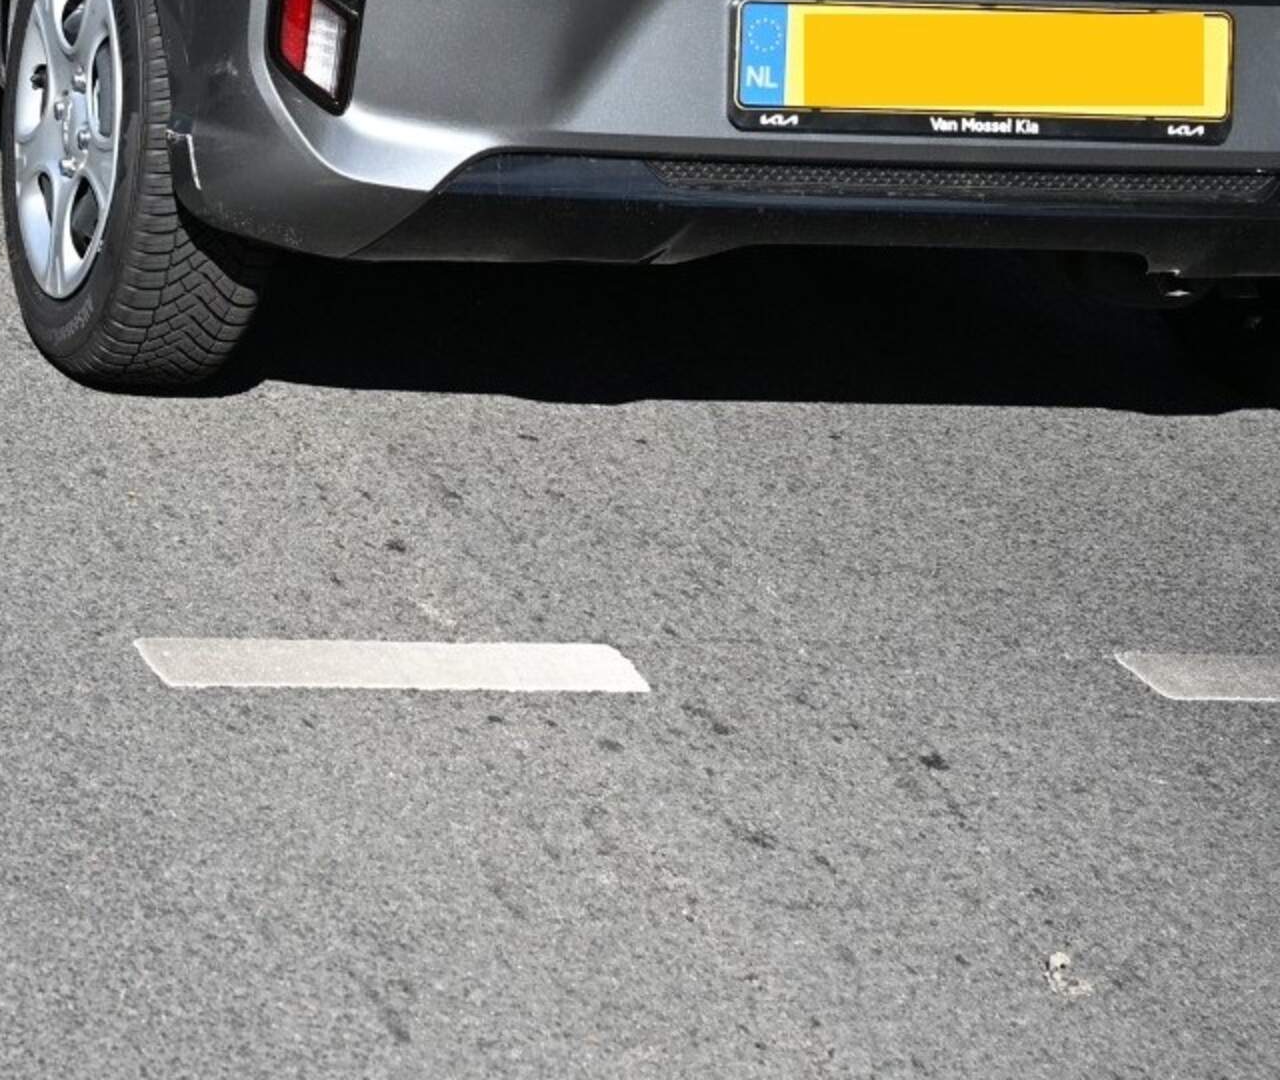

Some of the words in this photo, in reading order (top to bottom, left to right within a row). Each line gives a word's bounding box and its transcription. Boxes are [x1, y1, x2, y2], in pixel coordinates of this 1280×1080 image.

[746, 65, 779, 88] NL
[930, 117, 958, 131] Van
[961, 118, 1012, 133] Mossel
[1015, 119, 1039, 134] Kia
